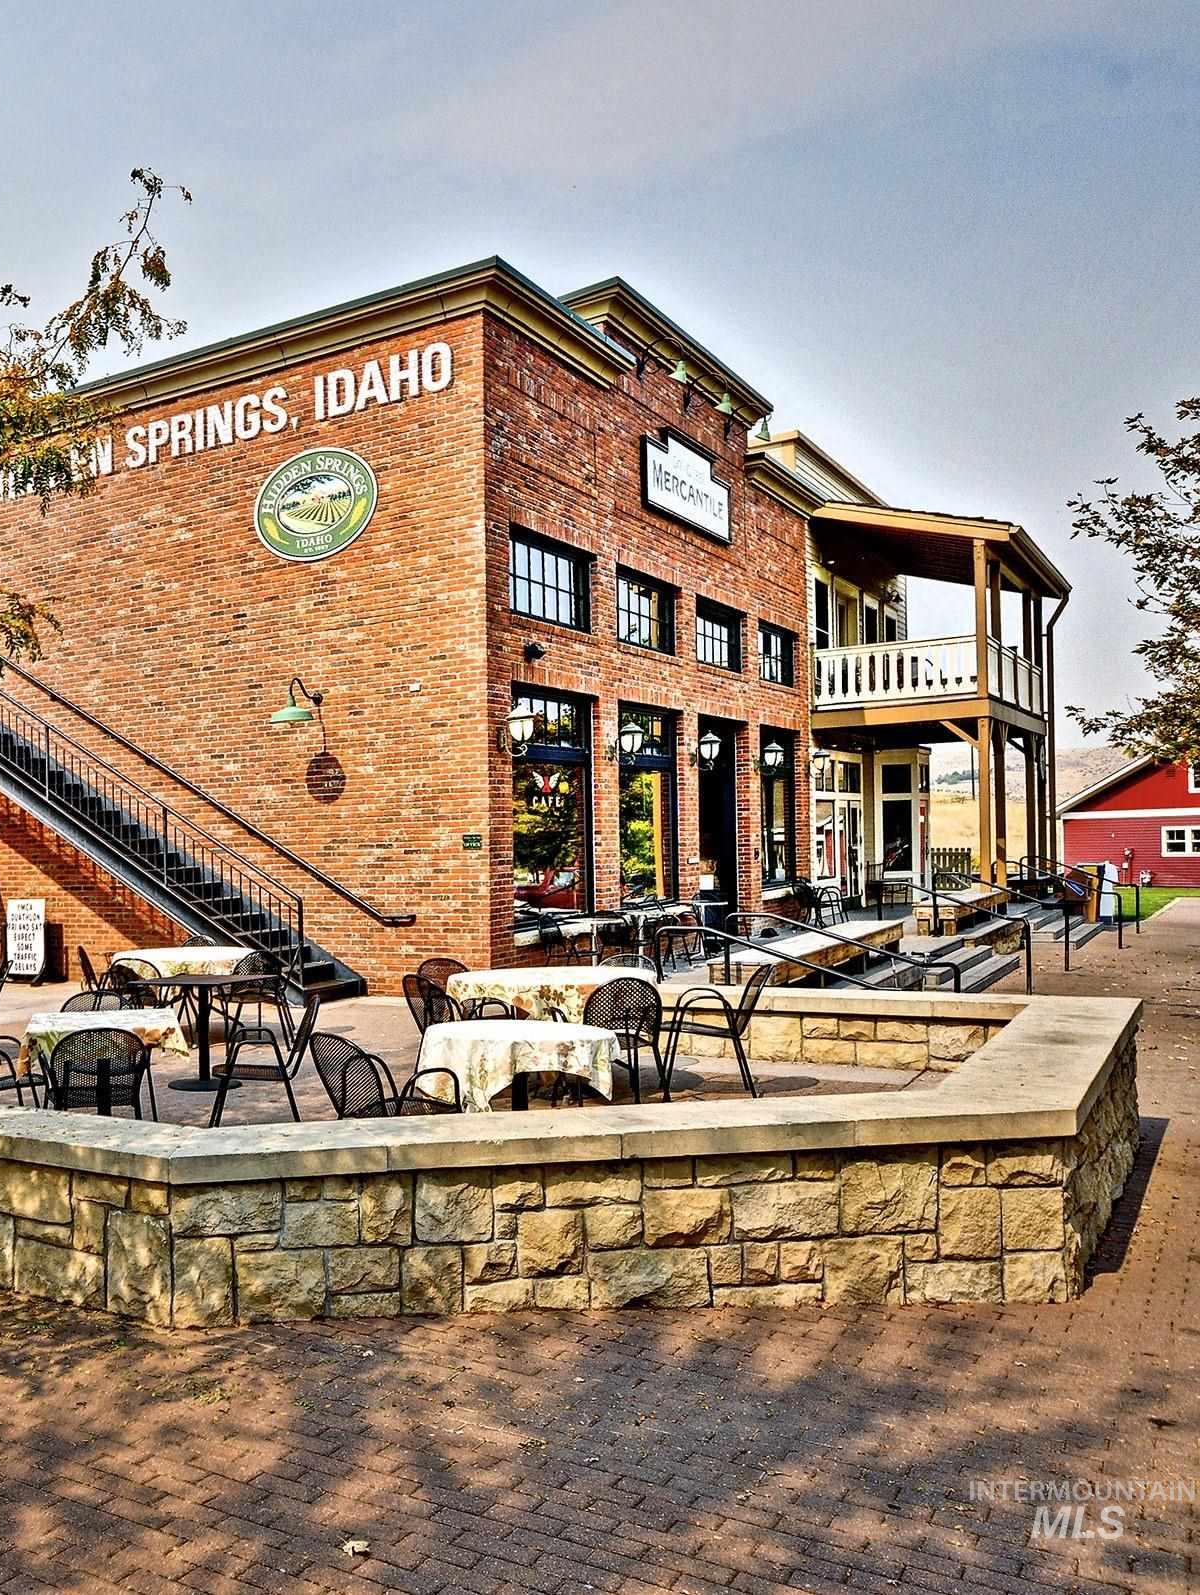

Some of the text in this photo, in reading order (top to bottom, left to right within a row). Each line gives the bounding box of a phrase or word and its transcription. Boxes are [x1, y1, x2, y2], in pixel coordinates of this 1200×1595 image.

[125, 386, 299, 468] SPRINGS,
[314, 341, 453, 421] IDAHO
[261, 455, 368, 513] HIDDEN SPRINGS
[652, 459, 724, 520] MERCANTILE
[296, 534, 332, 548] IDAHO
[14, 952, 37, 961] TRAFFIC
